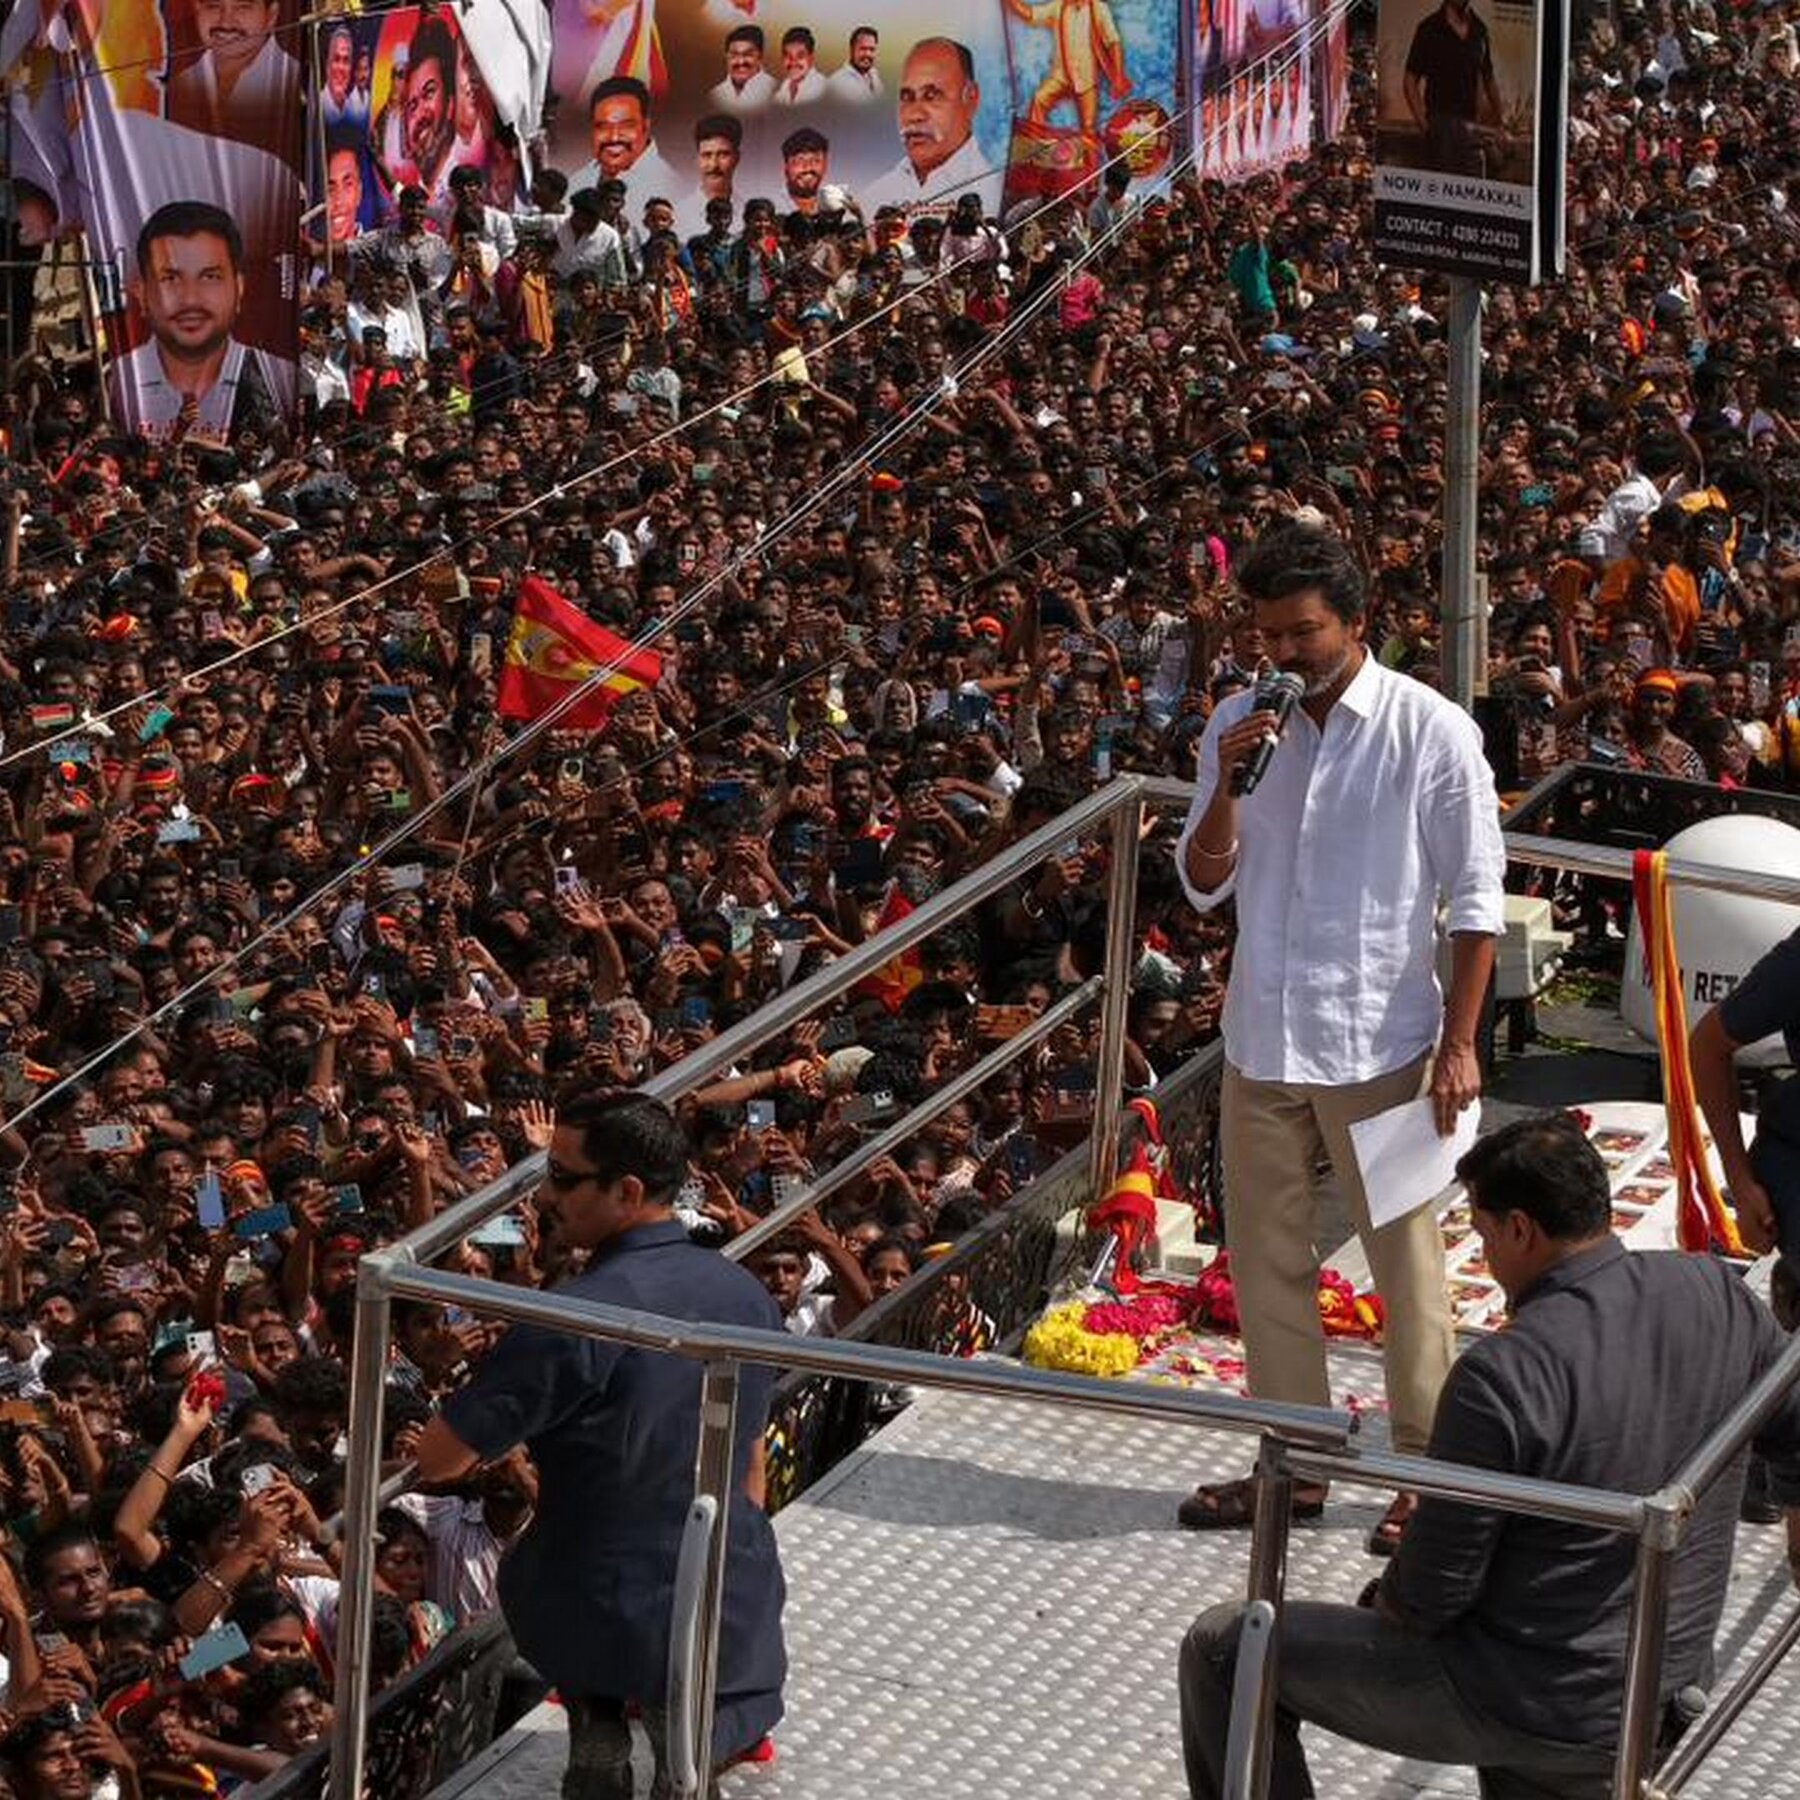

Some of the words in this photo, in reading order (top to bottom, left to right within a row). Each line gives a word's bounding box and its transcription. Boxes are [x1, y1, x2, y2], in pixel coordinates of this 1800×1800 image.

[1383, 175, 1421, 192] NOW
[1443, 182, 1524, 208] NAMAKKAL
[1386, 216, 1443, 236] CONTACT
